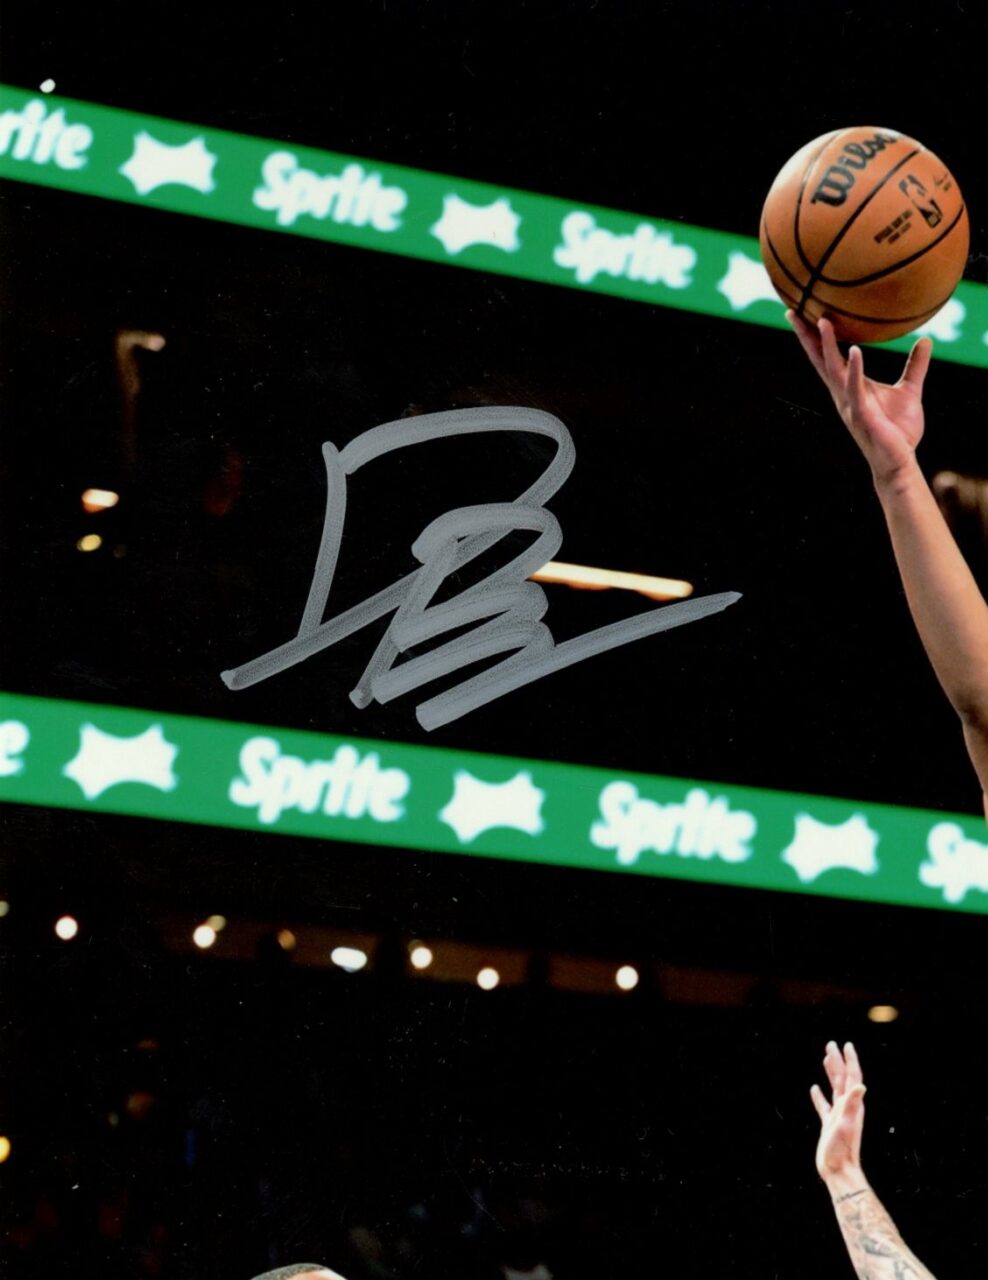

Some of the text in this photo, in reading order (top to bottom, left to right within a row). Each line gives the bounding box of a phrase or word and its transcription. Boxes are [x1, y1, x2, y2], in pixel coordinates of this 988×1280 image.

[253, 151, 407, 231] Sprite
[553, 211, 696, 288] Sprite
[229, 736, 411, 824] Sprite
[590, 781, 757, 865] Sprite
